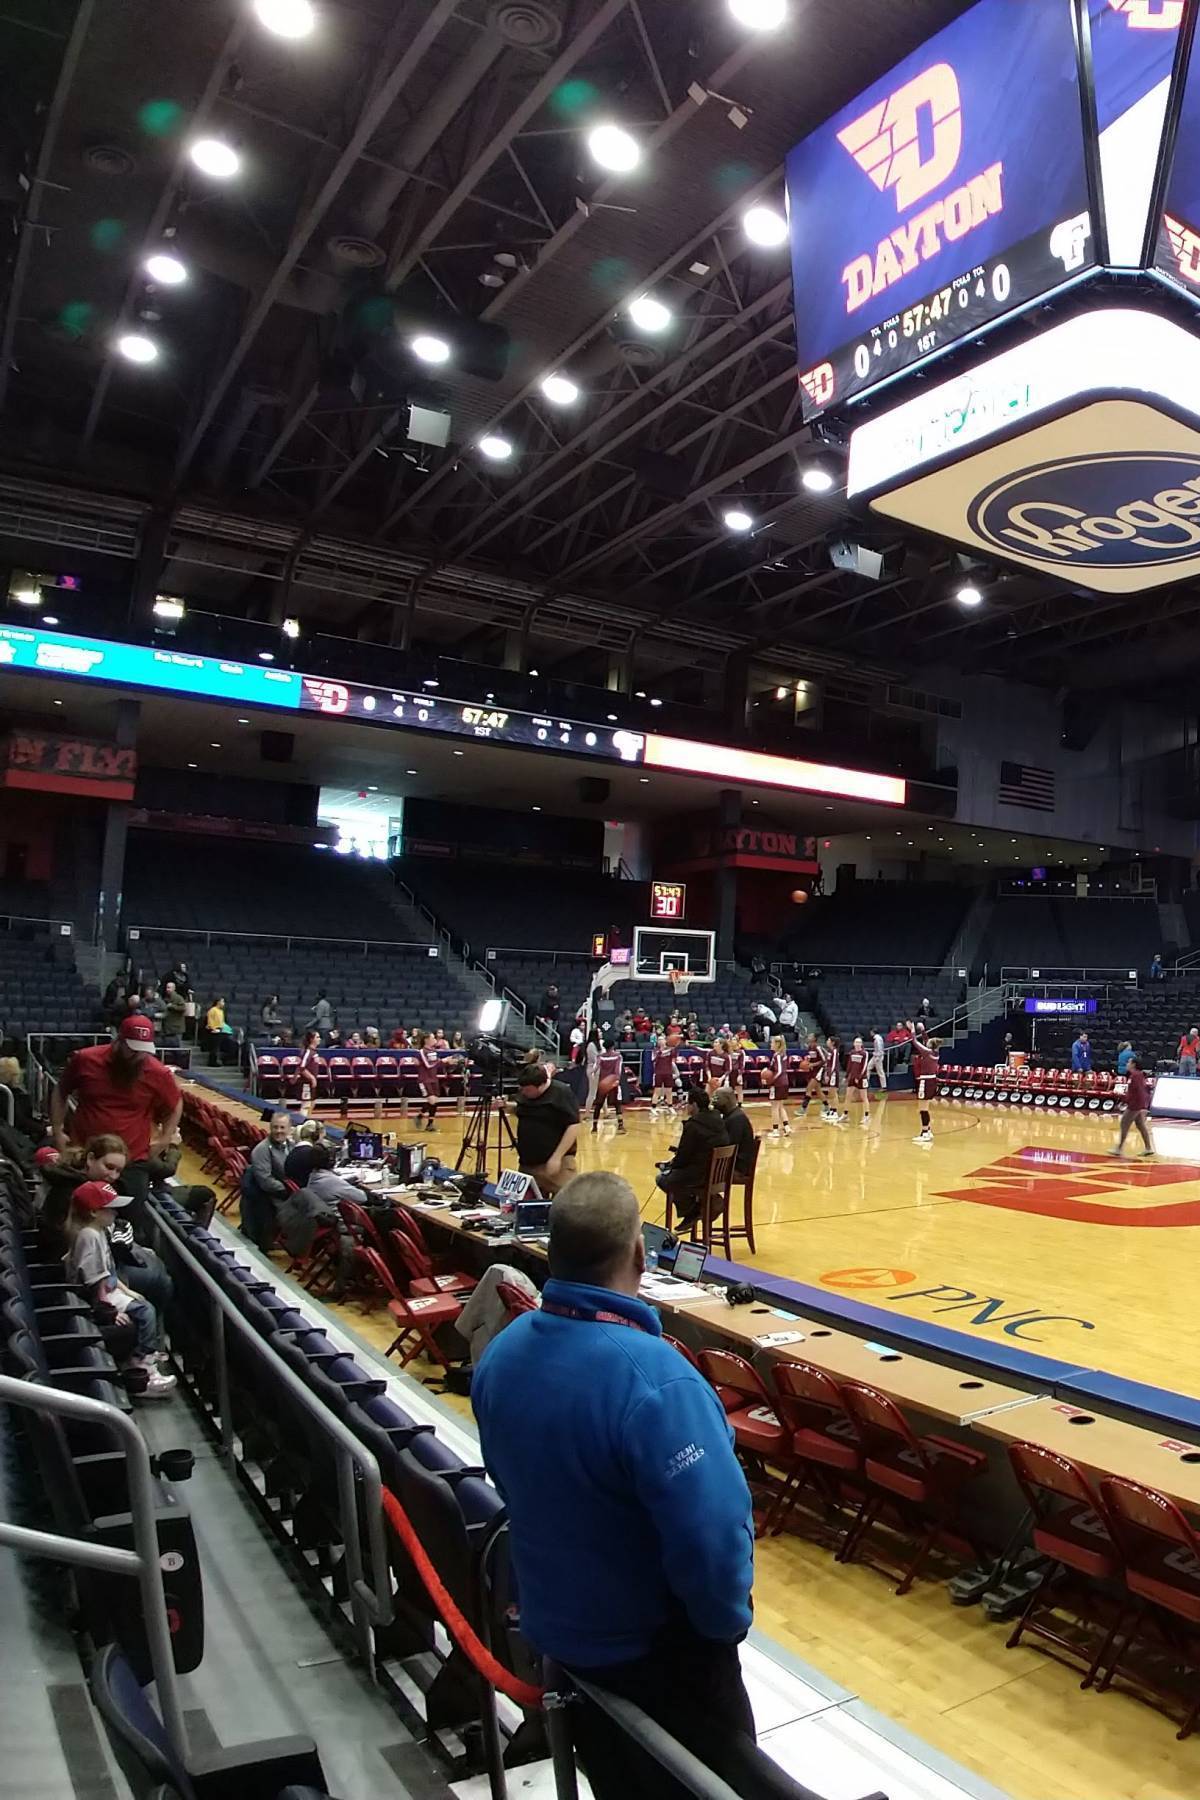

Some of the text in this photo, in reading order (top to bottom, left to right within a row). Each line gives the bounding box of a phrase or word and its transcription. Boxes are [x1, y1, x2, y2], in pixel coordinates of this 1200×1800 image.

[842, 161, 1003, 313] DAYTON
[854, 263, 1010, 378] 0 4 0 57:47 0 4 0
[917, 330, 937, 353] 1ST
[393, 706, 403, 718] 4
[418, 709, 428, 722] 0
[461, 707, 508, 728] 57:47
[537, 728, 547, 740] 0
[561, 732, 570, 744] 4
[474, 726, 492, 737] 1ST
[654, 885, 681, 898] 57:47
[656, 896, 678, 916] 30
[1036, 1002, 1057, 1011] BUD
[886, 1284, 1096, 1342] PNC
